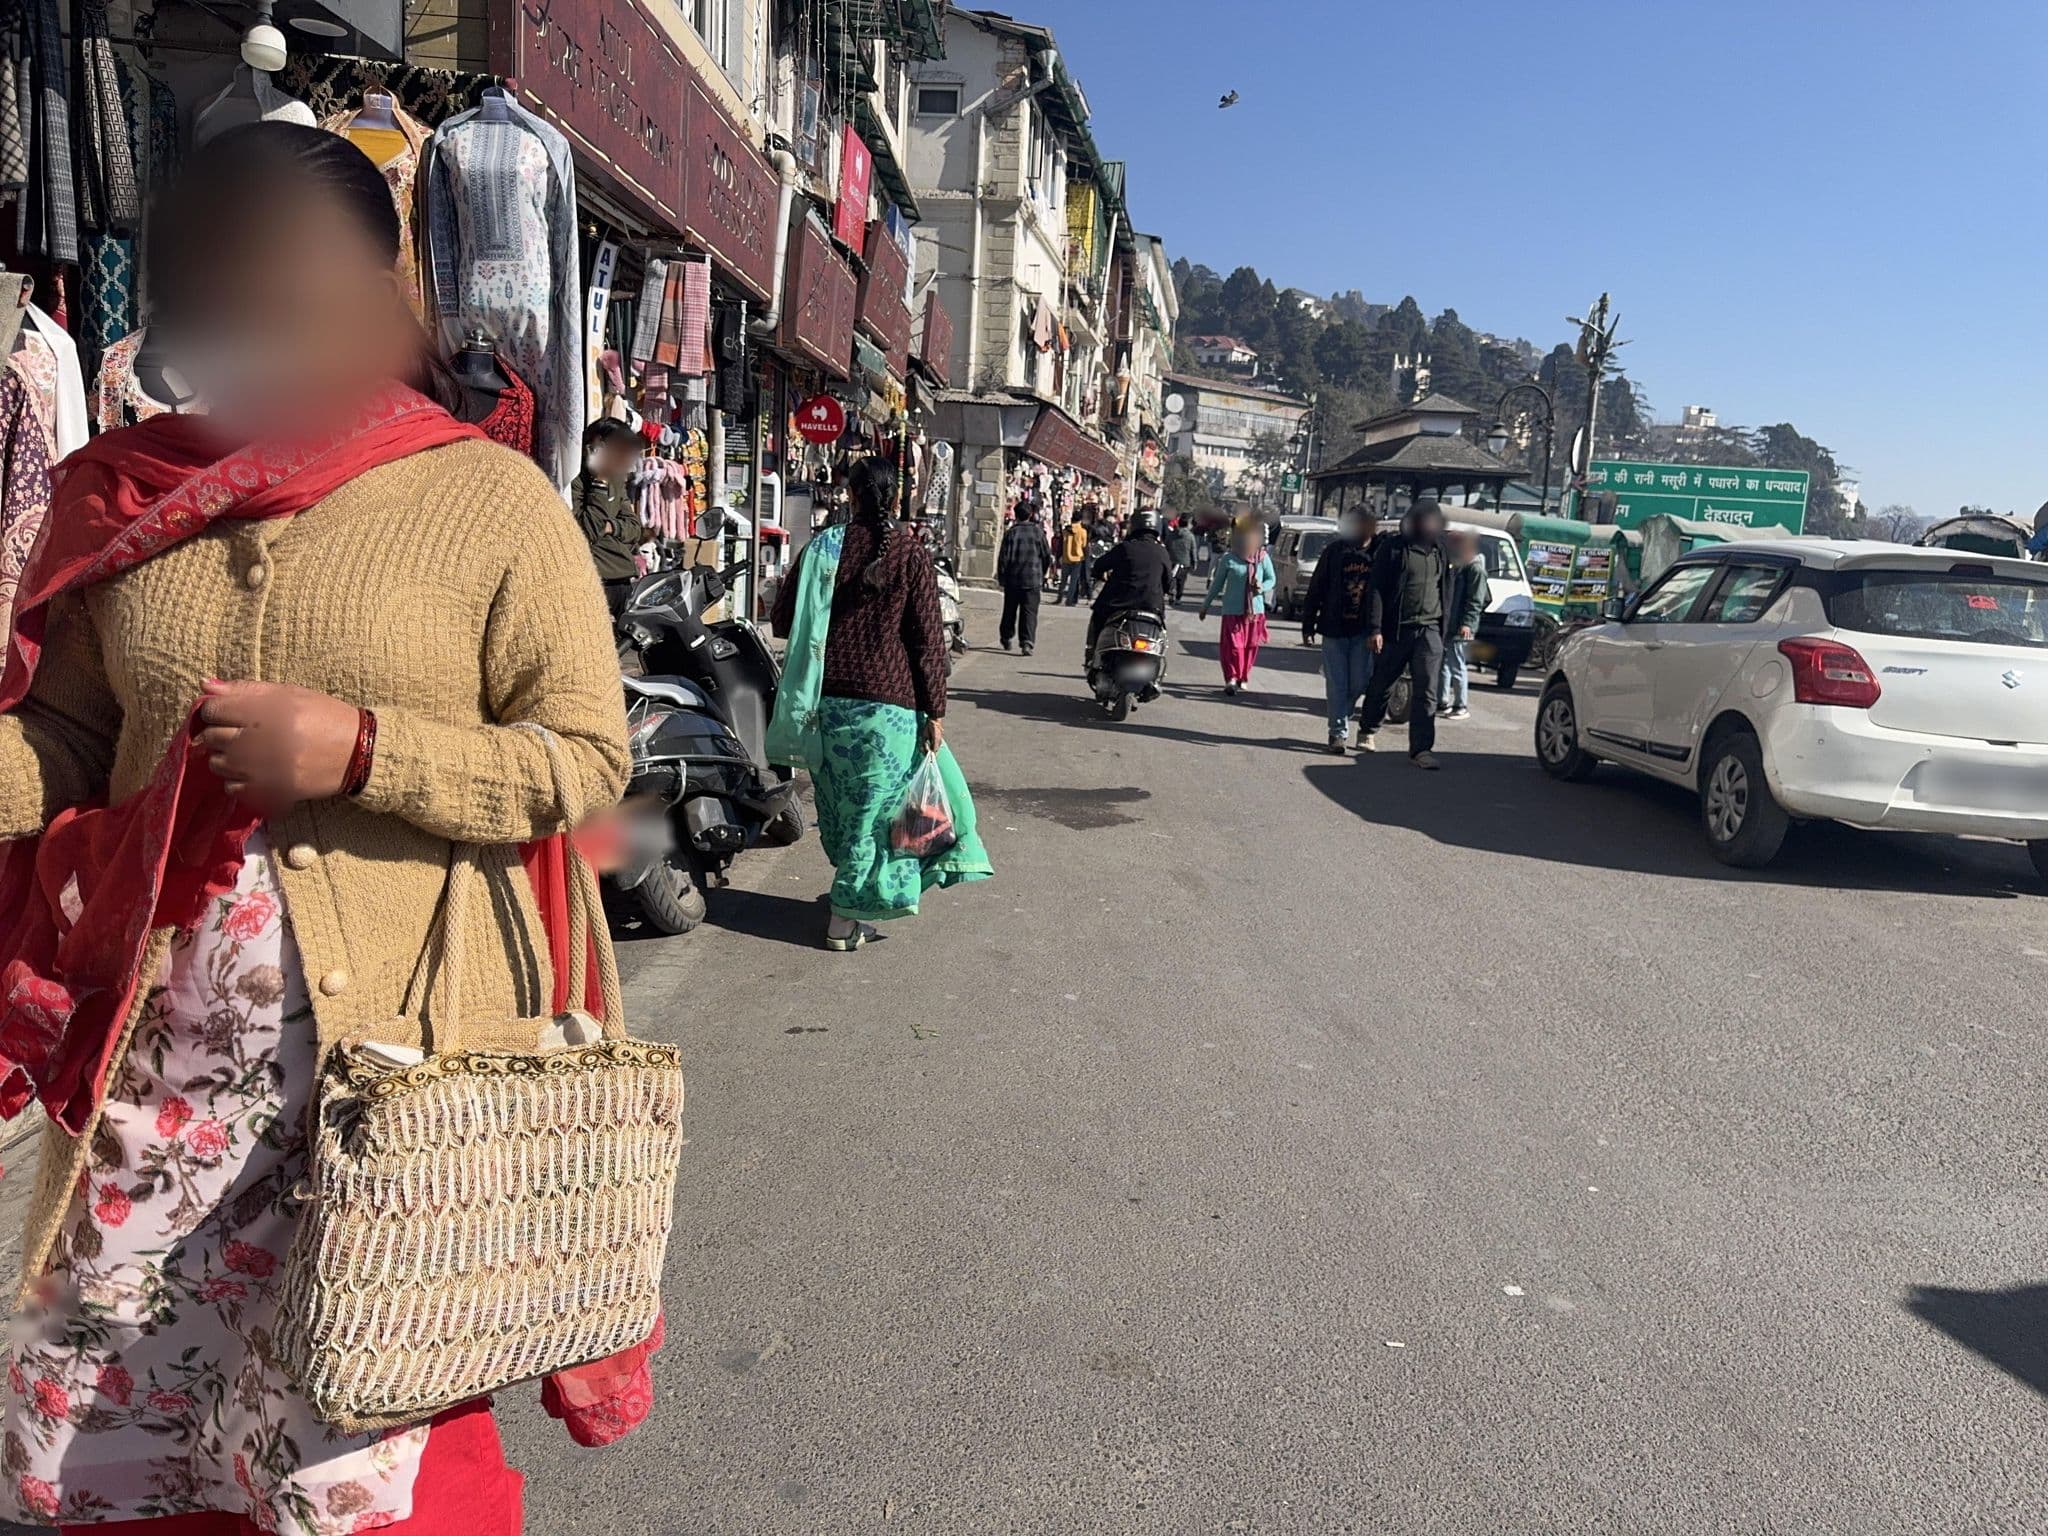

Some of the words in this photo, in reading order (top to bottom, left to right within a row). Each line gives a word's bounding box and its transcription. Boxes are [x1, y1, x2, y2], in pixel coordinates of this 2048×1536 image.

[597, 14, 635, 86] ATUL
[535, 4, 583, 88] PURE
[589, 58, 673, 168] VEGETARIAN
[593, 247, 611, 333] ATUL
[801, 422, 838, 432] HAVELLS
[1614, 468, 1628, 484] की
[1634, 470, 1655, 486] रानी
[1661, 471, 1687, 491] मसूरी
[1693, 473, 1703, 488] में
[1709, 475, 1740, 490] पधारने
[1746, 479, 1760, 492] का
[1703, 504, 1754, 527] देहरादून
[1548, 584, 1564, 595] SPA
[1591, 584, 1606, 595] SPA
